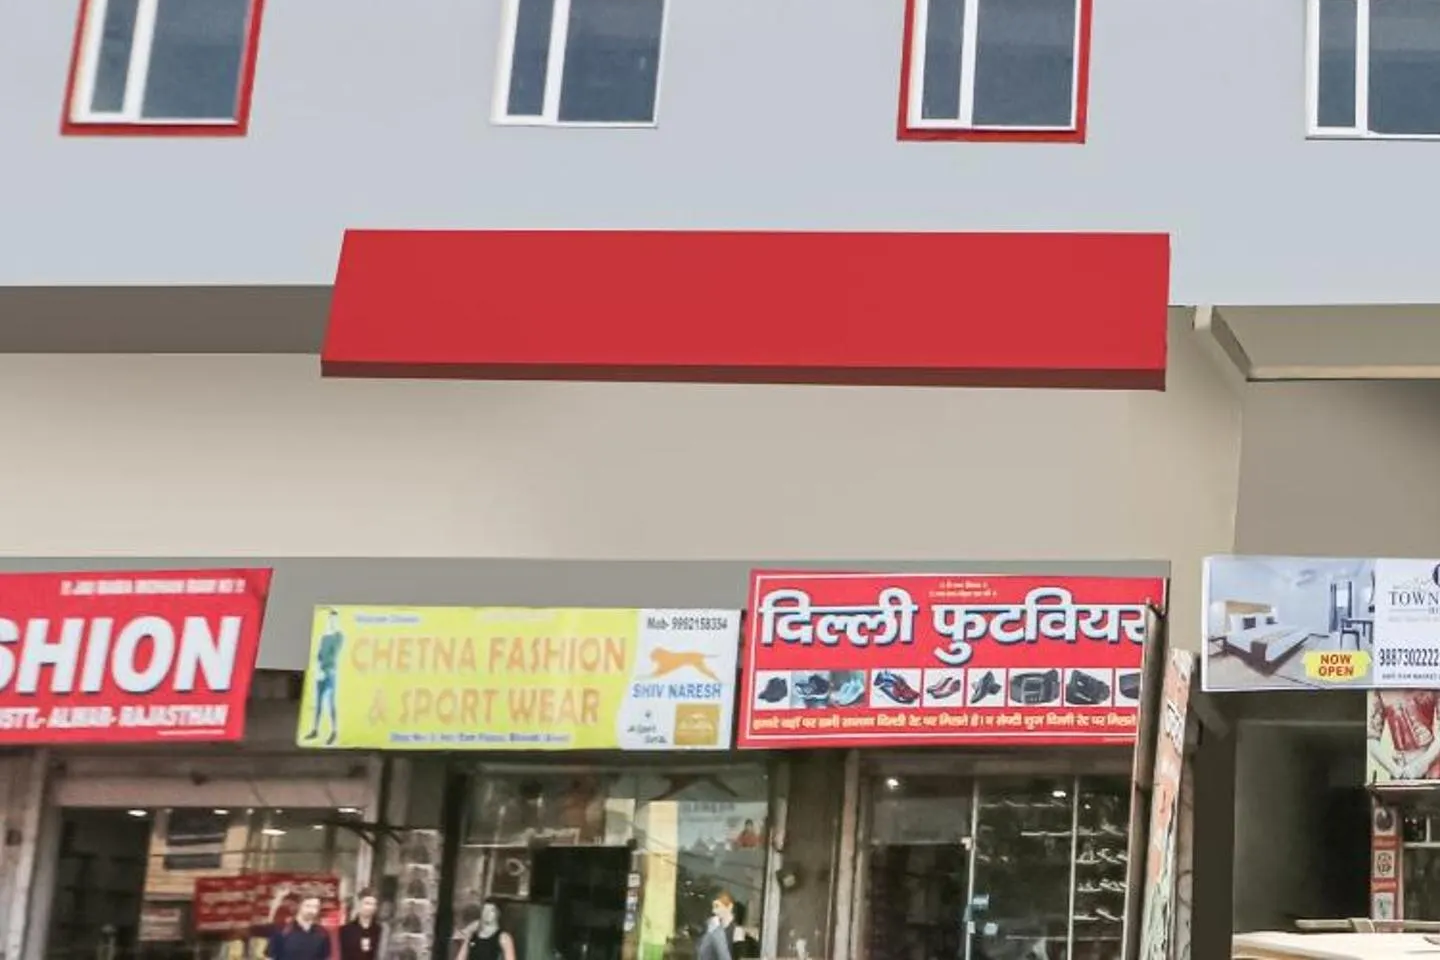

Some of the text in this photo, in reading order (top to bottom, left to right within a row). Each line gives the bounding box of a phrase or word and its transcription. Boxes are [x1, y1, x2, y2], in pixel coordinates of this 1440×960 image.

[1388, 591, 1439, 606] TOWN
[759, 586, 1146, 662] दिल्ली फुटवियर
[351, 637, 626, 672] CHETNA FASHION
[1320, 654, 1352, 665] NOW
[1318, 666, 1354, 677] OPEN
[632, 683, 722, 699] SHIV NARESH
[368, 688, 600, 725] & SPORT WEAR
